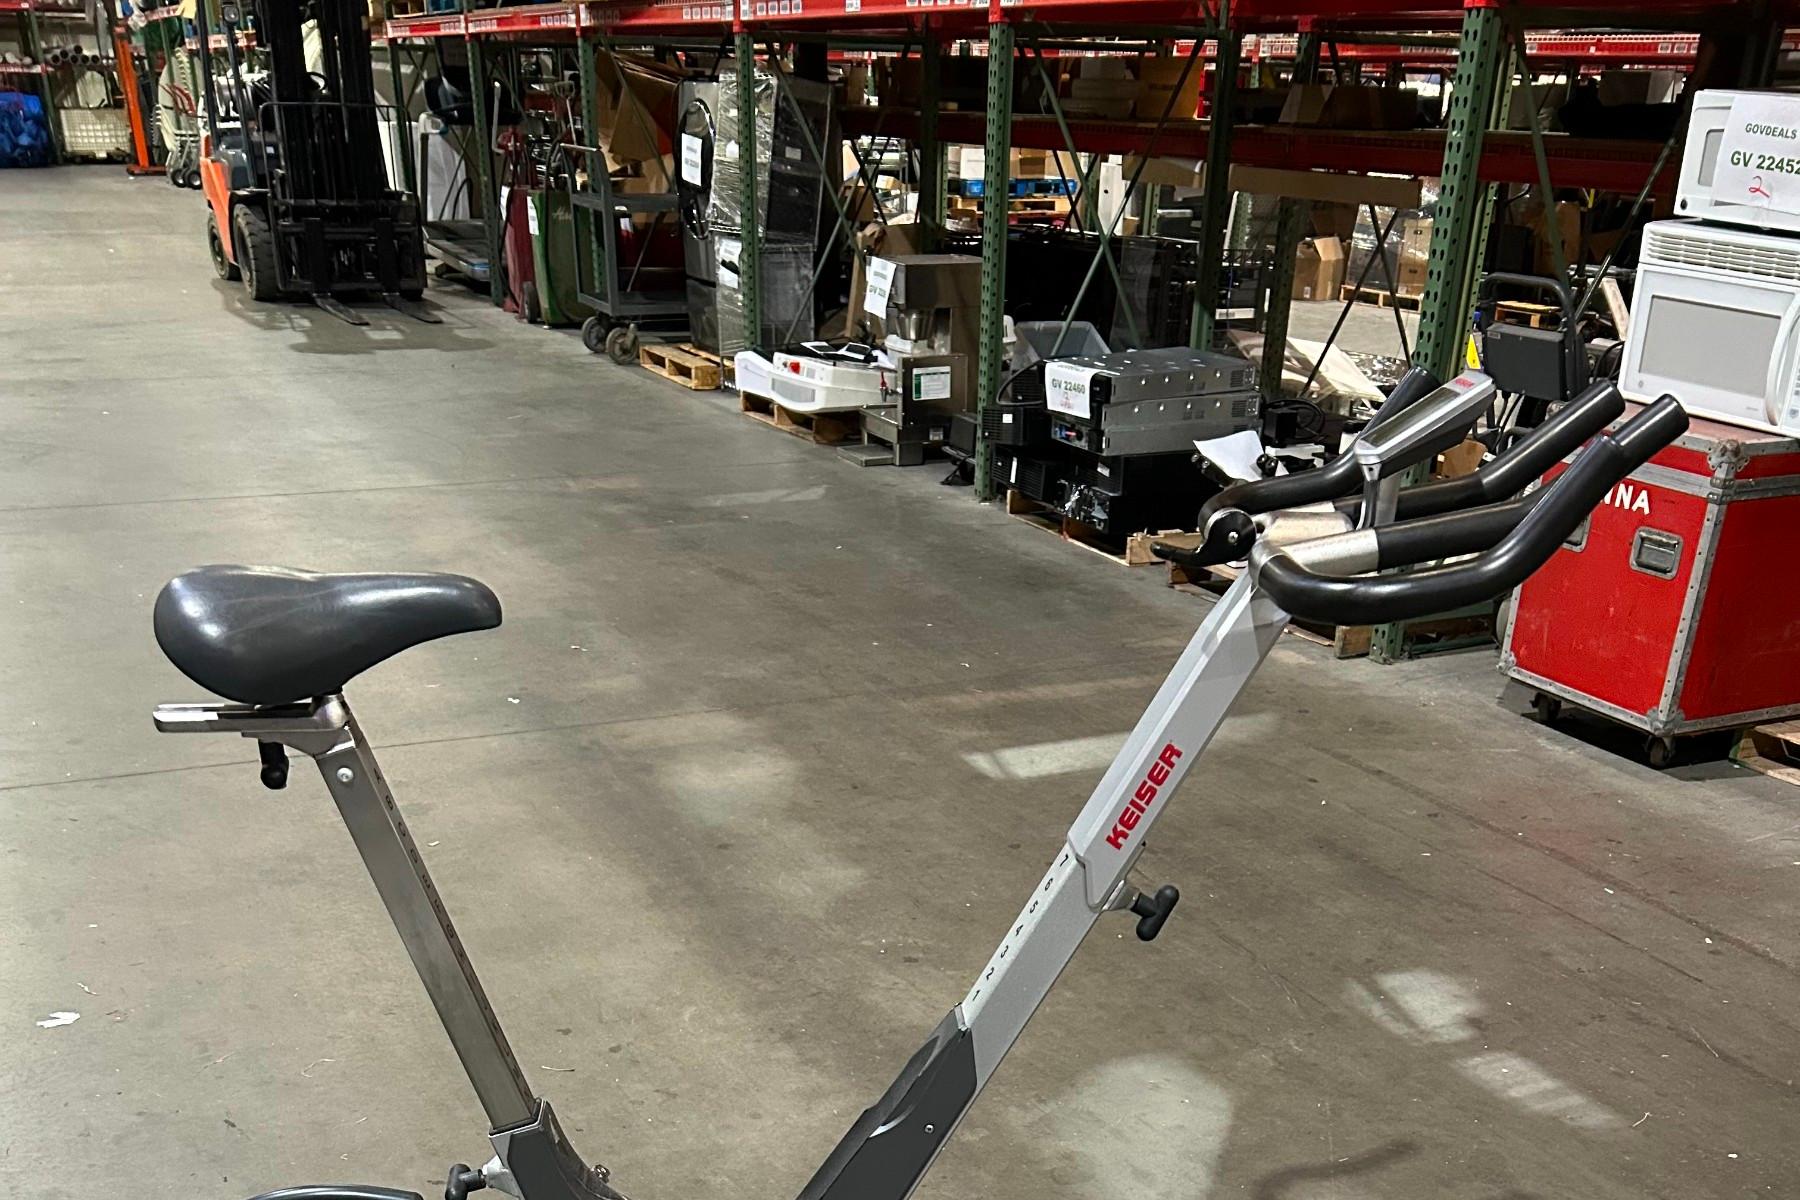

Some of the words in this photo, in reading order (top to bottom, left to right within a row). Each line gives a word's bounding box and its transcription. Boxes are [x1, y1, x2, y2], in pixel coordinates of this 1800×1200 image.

[1745, 123, 1797, 139] GOVDEALS
[1731, 151, 1753, 167] GV
[1051, 378, 1062, 389] GV
[1105, 743, 1183, 851] KEISER
[1060, 853, 1069, 867] 7
[1044, 877, 1054, 891] 6
[1029, 900, 1039, 914] 5
[1015, 924, 1024, 937] 4
[1000, 945, 1009, 958] 3
[986, 966, 995, 981] 2
[972, 989, 981, 1002] 1
